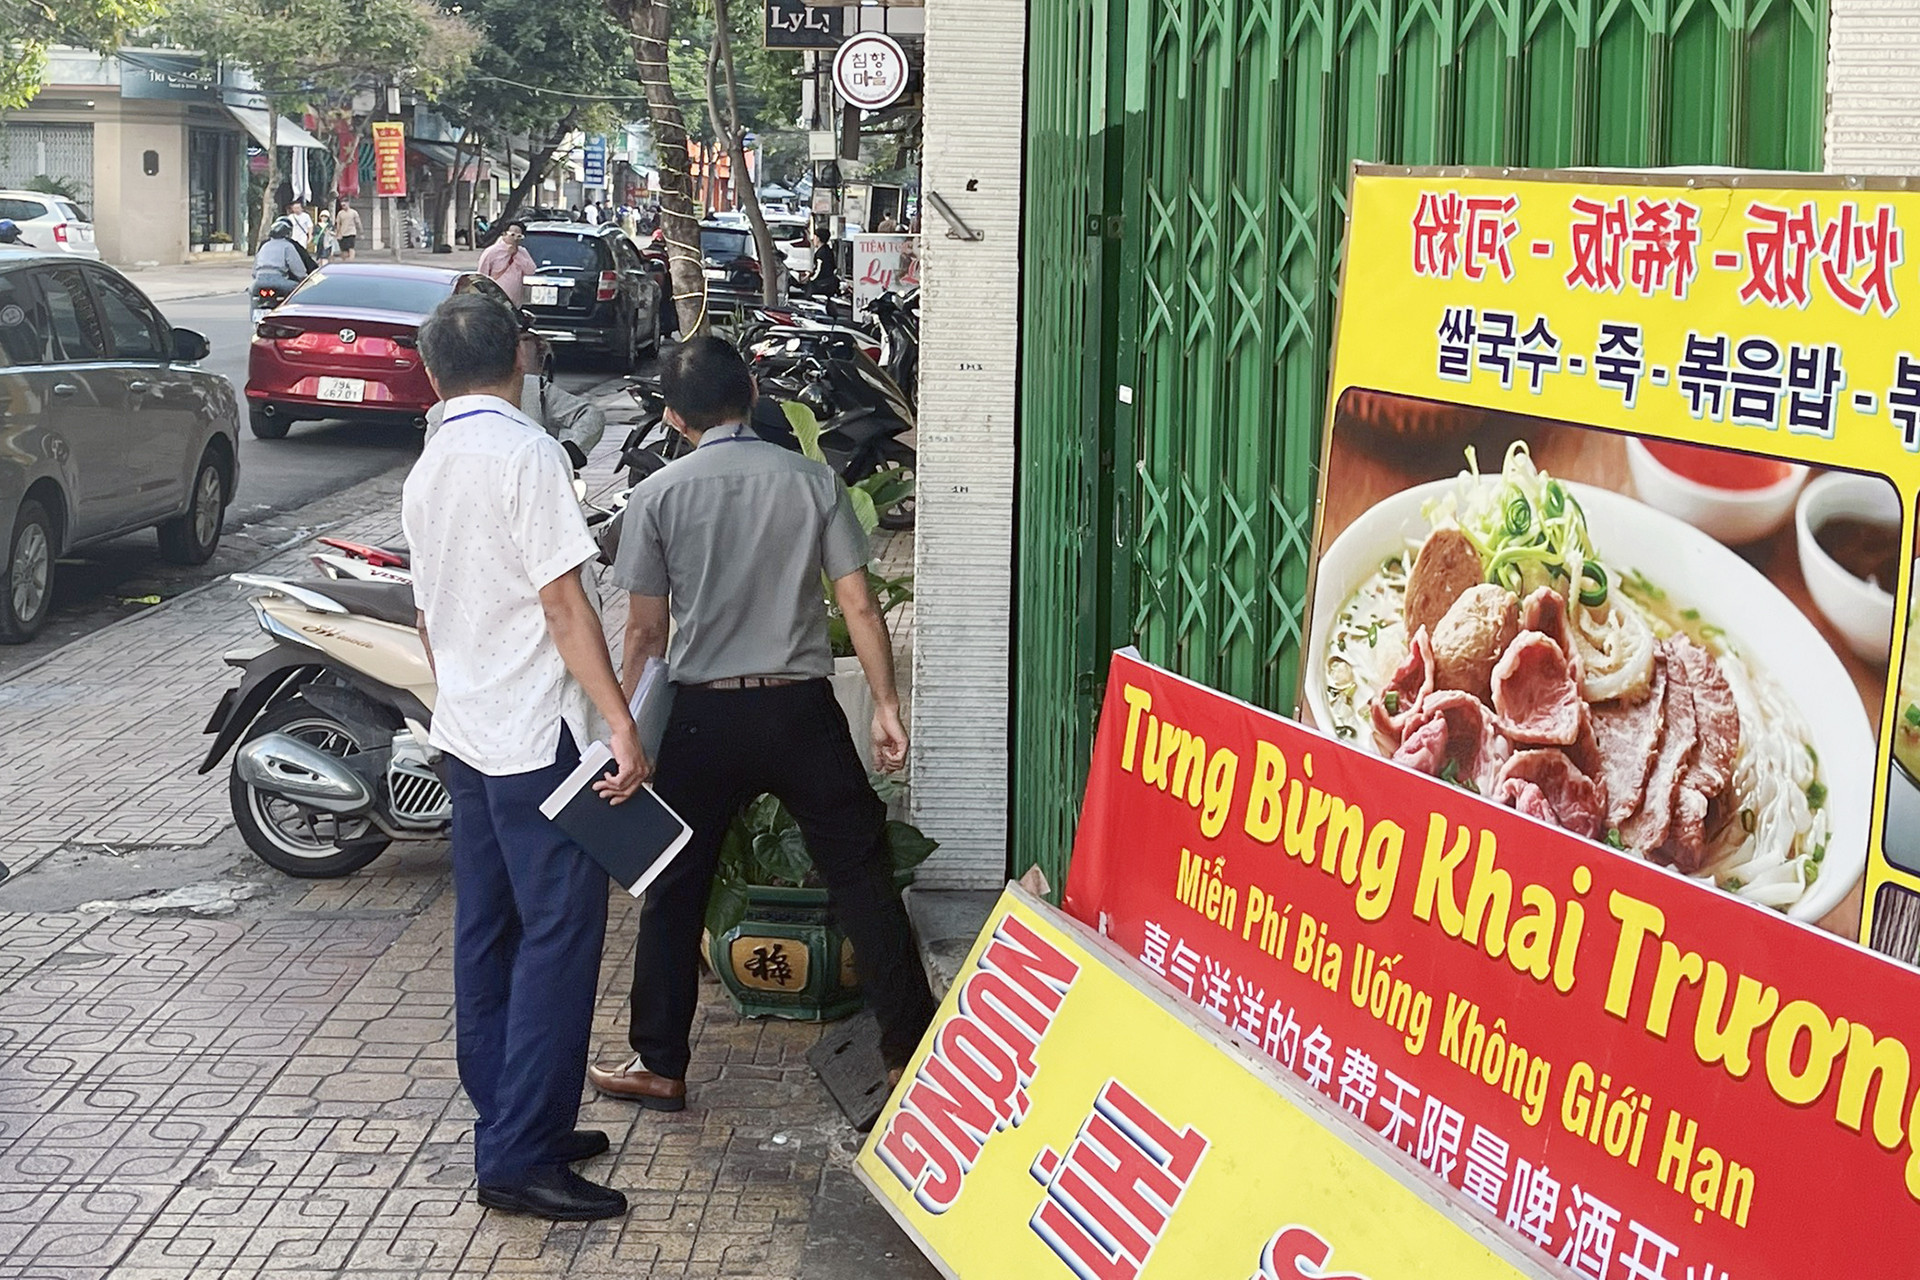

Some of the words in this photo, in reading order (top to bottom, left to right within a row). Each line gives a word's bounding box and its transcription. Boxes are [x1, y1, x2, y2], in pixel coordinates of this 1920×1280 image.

[1437, 307, 1559, 389] 쌀국수
[1595, 324, 1641, 403] 죽
[1678, 333, 1842, 432] 볶음밥
[1122, 683, 1238, 838] Tưng
[1245, 741, 1402, 921] Bừng
[1414, 815, 1593, 992] Khai
[877, 914, 1080, 1211] NƯỚNG
[1139, 919, 1730, 1280] 喜气洋洋的免费无限量啤酒开
[1177, 849, 1236, 932] Miễn
[1243, 887, 1292, 961] Phí
[1292, 912, 1343, 993] Bia
[1351, 942, 1432, 1056] Uống
[1439, 993, 1550, 1127] Không
[1561, 1061, 1653, 1166] Giới
[1656, 1110, 1756, 1229] Hạn
